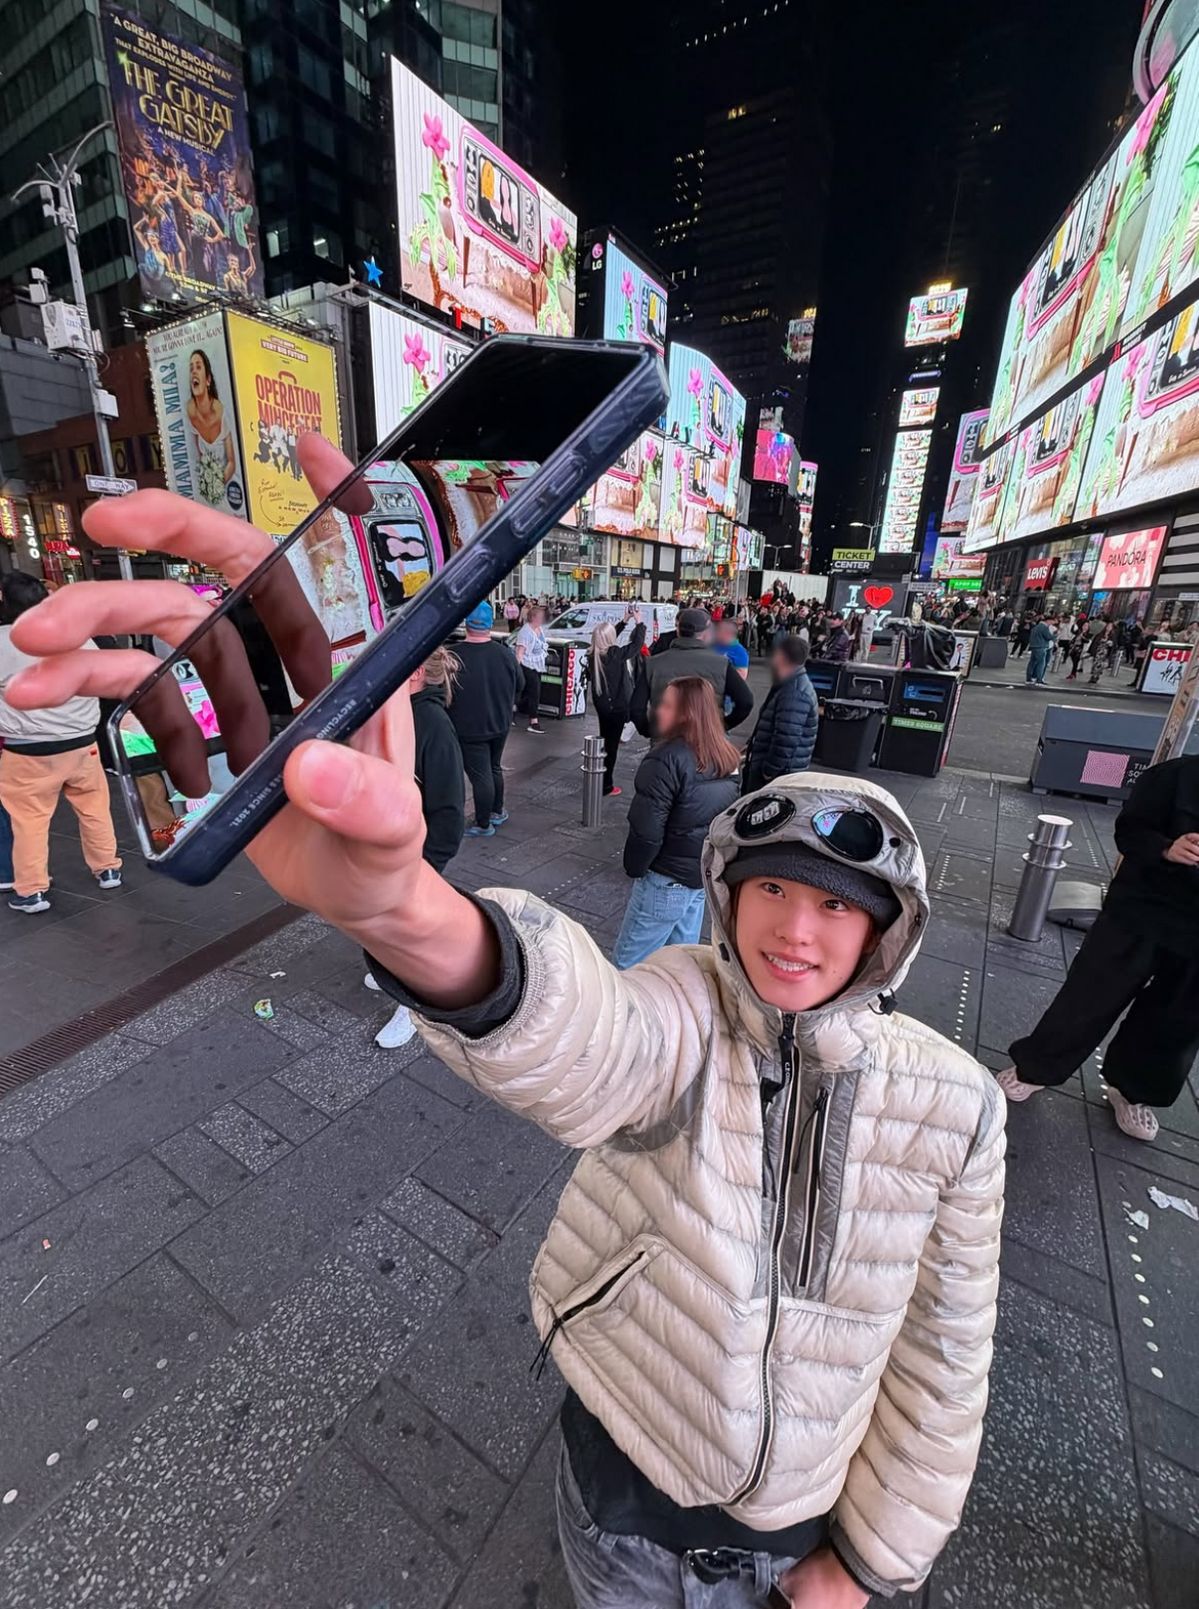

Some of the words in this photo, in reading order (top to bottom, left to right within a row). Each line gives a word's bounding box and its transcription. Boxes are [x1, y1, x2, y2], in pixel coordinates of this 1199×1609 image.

[123, 20, 160, 46] GREAT,
[161, 38, 179, 54] BIG
[181, 48, 232, 81] BROADWAY
[137, 37, 215, 84] EXTRAVAGANZA
[123, 58, 162, 99] THE
[165, 79, 234, 132] GREAT
[139, 94, 225, 150] GATSBY
[157, 126, 164, 135] A
[164, 129, 181, 142] NEW
[182, 134, 215, 156] MUSICAL
[592, 259, 602, 271] LG
[255, 374, 322, 416] OPERATION
[168, 419, 194, 500] MAMMA
[23, 514, 40, 559] 1540
[837, 551, 872, 560] TICKET
[834, 561, 870, 569] CENTER
[1106, 551, 1147, 568] PANDORA
[846, 585, 861, 607] I
[565, 650, 576, 717] CHICAGO
[316, 699, 358, 740] RECYCLING
[229, 808, 251, 828] 2021.
[248, 787, 273, 811] SINCE
